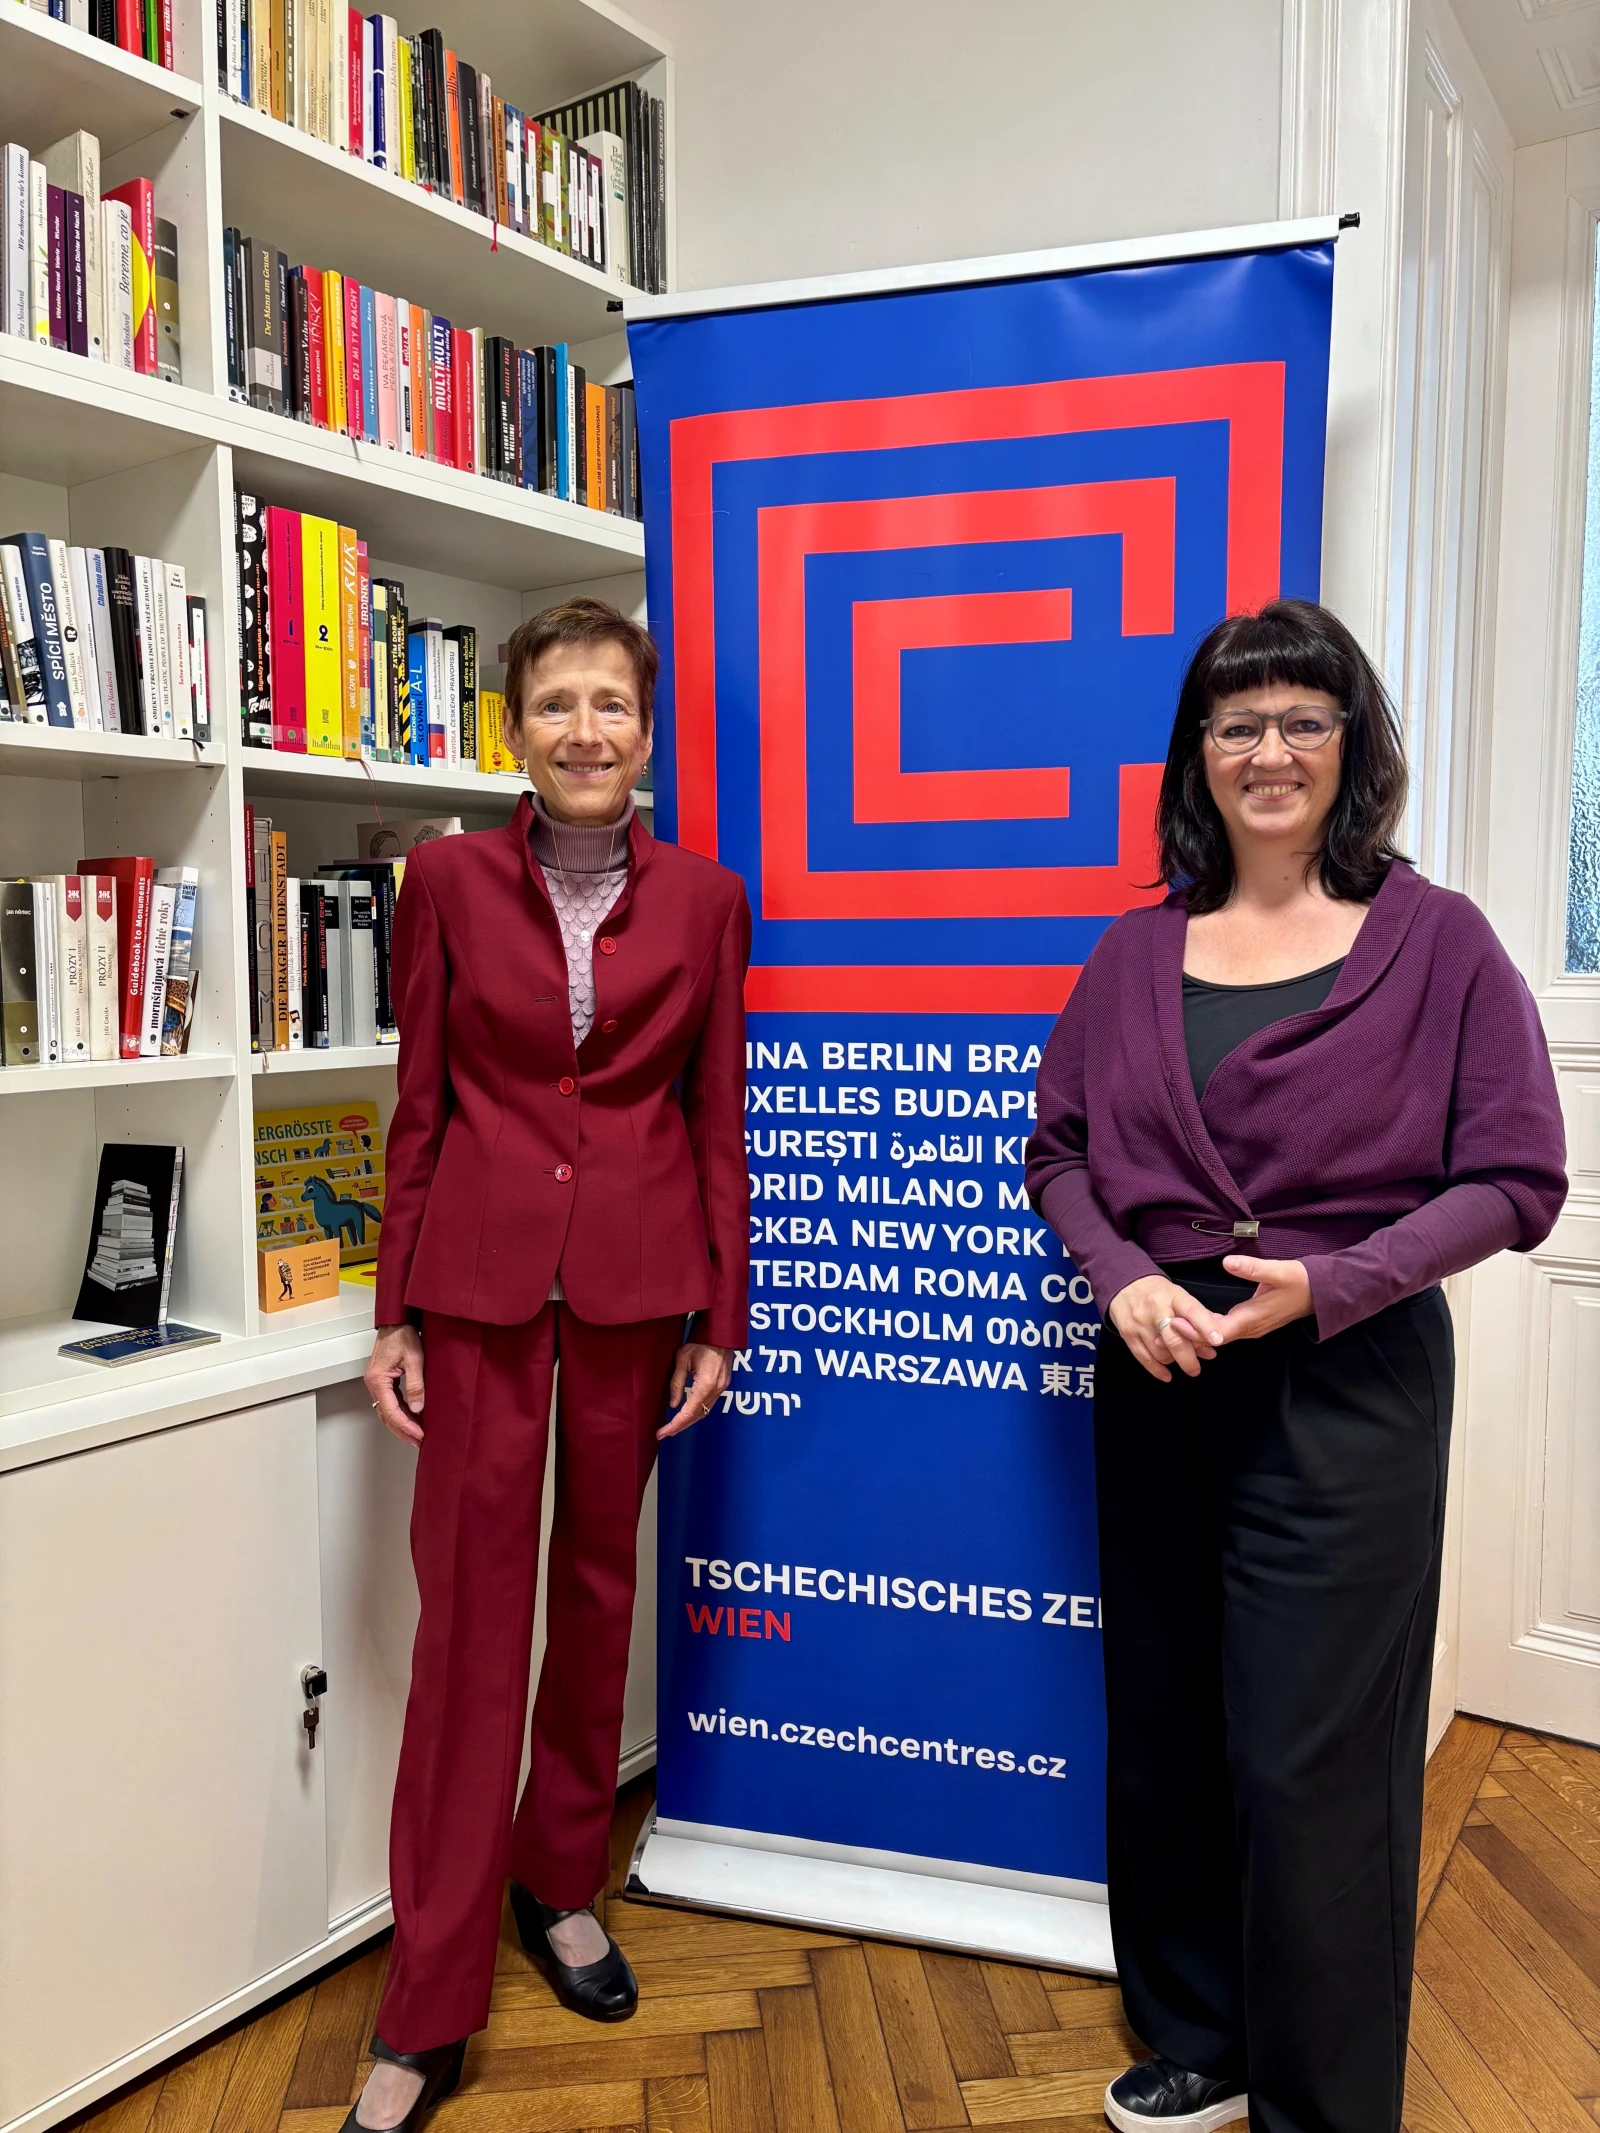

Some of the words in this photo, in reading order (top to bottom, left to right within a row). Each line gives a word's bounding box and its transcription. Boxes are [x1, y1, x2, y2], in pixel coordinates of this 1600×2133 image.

[118, 209, 131, 226] je
[120, 225, 128, 240] co
[120, 244, 131, 296] Bereme,
[262, 250, 270, 278] Grund
[264, 280, 270, 292] am
[350, 288, 358, 330] PRACHY
[122, 313, 130, 348] Nosková
[264, 320, 272, 336] Der
[351, 330, 358, 344] TY
[380, 314, 388, 371] PEKÁRKOVÁ
[352, 346, 359, 360] MI
[434, 325, 446, 411] MULTIKULTI
[352, 363, 360, 381] DEJ
[58, 547, 66, 579] Evolution
[92, 554, 102, 574] muže
[344, 542, 356, 596] RUR
[96, 574, 106, 606] Chraňme
[360, 576, 368, 626] HRDINKY
[40, 582, 59, 637] MĚSTO
[256, 628, 264, 659] neznáma
[318, 624, 329, 642] 2
[390, 614, 398, 641] DOBRÝ
[48, 641, 65, 681] SPÍCÍ
[348, 673, 356, 690] ČAPEK
[410, 664, 422, 692] A-L
[108, 702, 116, 720] Věra
[416, 700, 424, 743] SLOVNÍK
[448, 694, 456, 728] ČESKÉHO
[135, 876, 146, 928] Monuments
[276, 842, 286, 936] JUDENSTADT
[159, 900, 171, 924] roky
[134, 930, 142, 940] to
[156, 928, 167, 954] tiché
[67, 952, 78, 986] PRÓZY
[96, 956, 107, 986] PRÓZY
[130, 942, 140, 996] Guidebook
[277, 940, 288, 996] PRAGER
[150, 957, 166, 1029] mornštajnová
[278, 998, 288, 1022] DIE
[822, 1042, 952, 1072] BERLIN
[968, 1044, 1044, 1073] BRA
[745, 1086, 880, 1116] XELLES
[254, 1119, 334, 1142] ERGRÖSSTE
[890, 1132, 982, 1168] القاهرة
[838, 1174, 984, 1208] MILANO
[852, 1220, 936, 1251] NEW
[942, 1224, 1048, 1257] YORK
[914, 1267, 1028, 1301] ROMA
[750, 1302, 972, 1342] STOCKHOLM
[759, 1345, 802, 1374] תל
[814, 1348, 1028, 1392] WARSZAWA
[719, 1386, 801, 1416] ירושל
[685, 1557, 1032, 1622] TSCHECHISCHES
[686, 1603, 792, 1642] WIEN
[688, 1708, 1066, 1778] wien.czechcentres.cz
